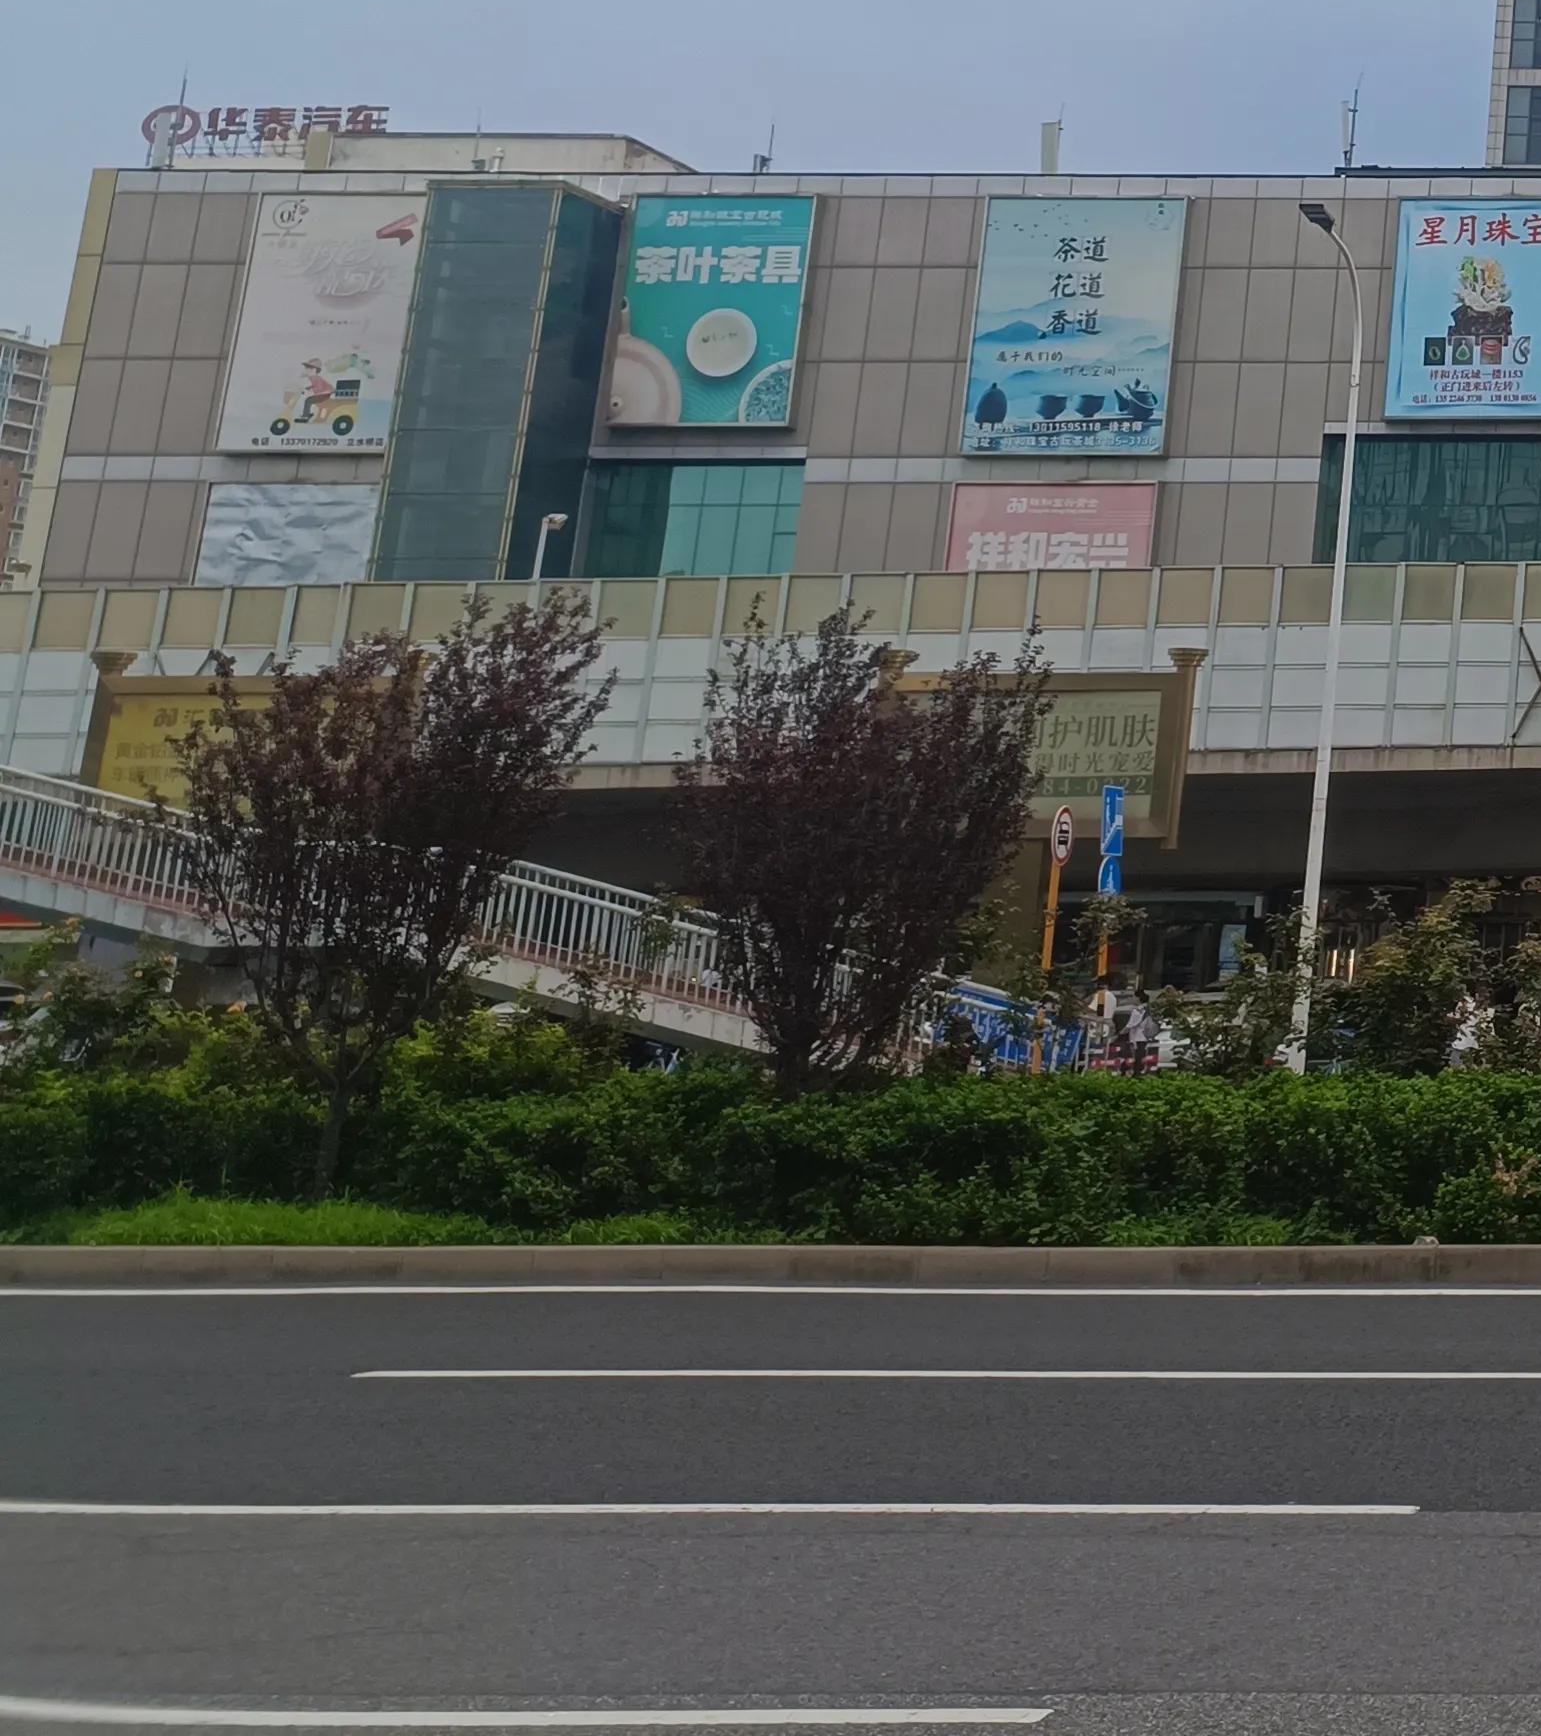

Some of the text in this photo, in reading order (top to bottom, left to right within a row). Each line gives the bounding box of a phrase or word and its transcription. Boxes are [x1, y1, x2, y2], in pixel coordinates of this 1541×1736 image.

[204, 105, 390, 141] 华泰汽车
[1053, 235, 1109, 264] 茶道
[635, 245, 802, 284] 茶叶茶具
[1050, 272, 1106, 300] 花道
[1046, 309, 1102, 337] 香道
